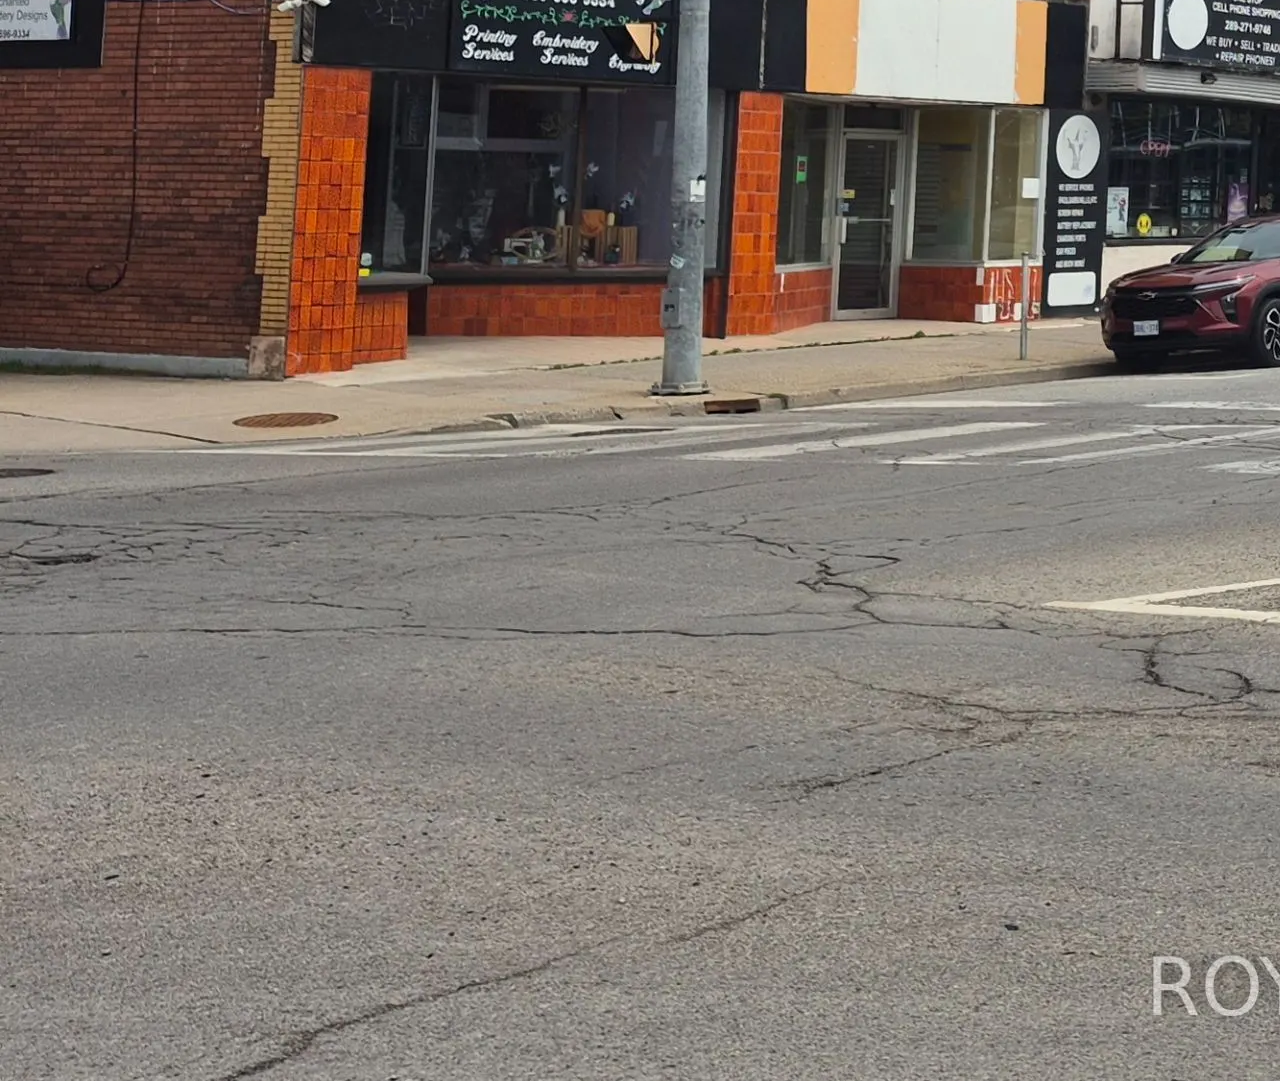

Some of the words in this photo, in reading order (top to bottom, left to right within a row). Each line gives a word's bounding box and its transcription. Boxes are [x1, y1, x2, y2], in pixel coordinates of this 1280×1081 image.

[16, 9, 48, 23] Designs
[1212, 1, 1229, 13] CELL
[1229, 3, 1251, 16] PHONE
[462, 23, 518, 47] Printing
[532, 29, 600, 54] Embroidery
[1206, 35, 1217, 47] WE
[1218, 36, 1233, 48] BUY
[1240, 39, 1255, 51] SELL
[461, 42, 515, 62] Services
[540, 48, 590, 67] Services
[1220, 51, 1245, 63] REPAIR
